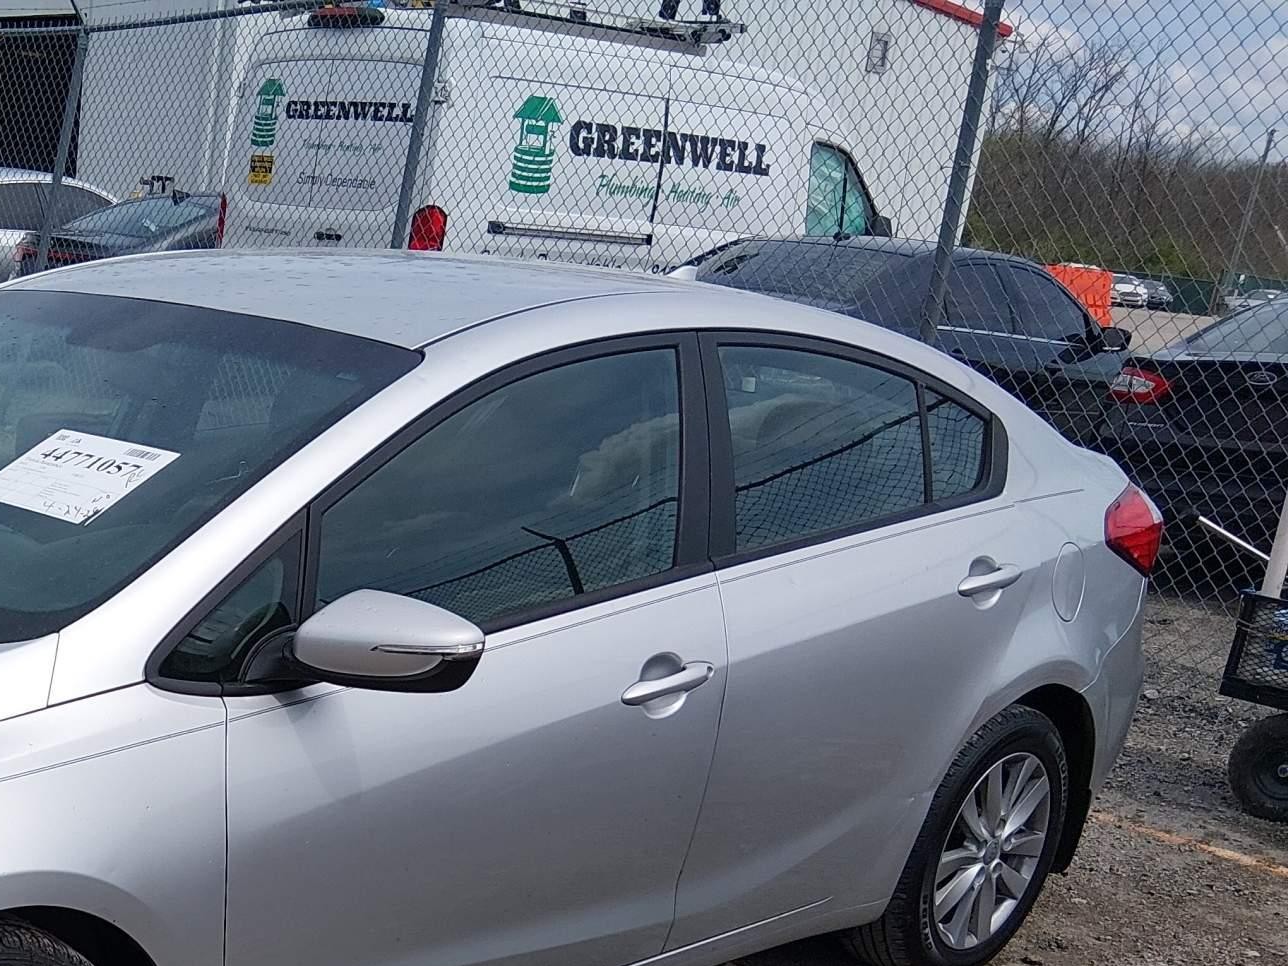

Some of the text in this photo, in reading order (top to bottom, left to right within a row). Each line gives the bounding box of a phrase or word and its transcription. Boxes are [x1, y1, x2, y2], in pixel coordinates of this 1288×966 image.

[286, 100, 414, 122] GREENWELL
[569, 120, 771, 176] GREENWELL
[325, 173, 376, 191] Dependable
[596, 173, 657, 206] Plumbing
[668, 182, 713, 213] Heating
[41, 447, 143, 478] 44771057
